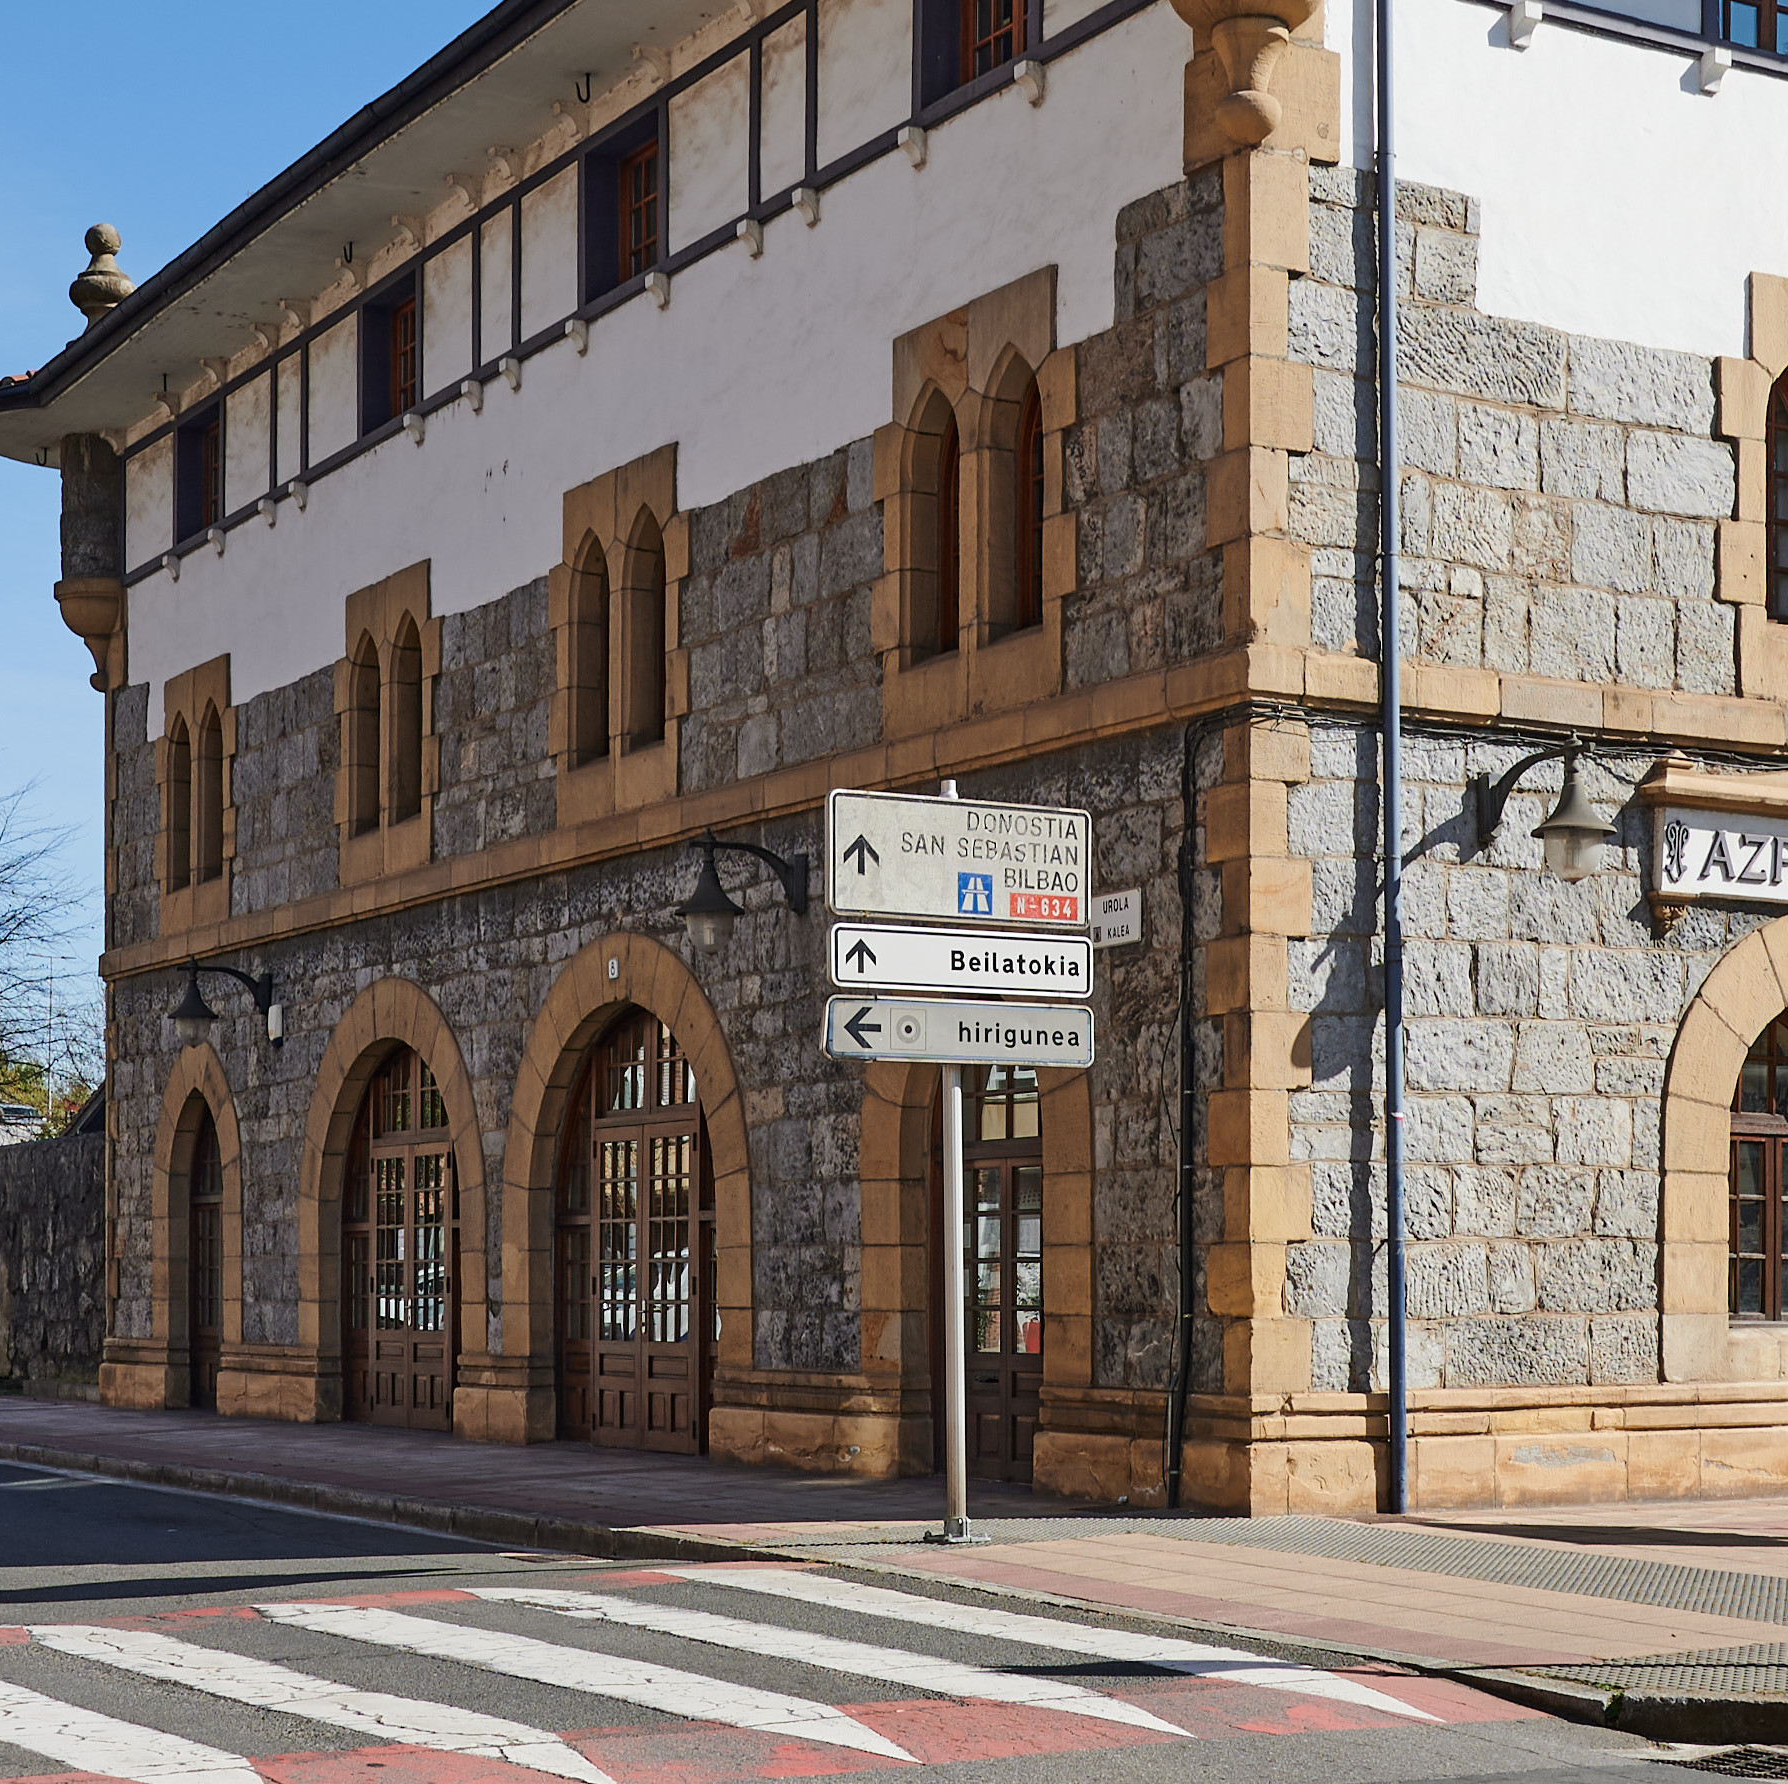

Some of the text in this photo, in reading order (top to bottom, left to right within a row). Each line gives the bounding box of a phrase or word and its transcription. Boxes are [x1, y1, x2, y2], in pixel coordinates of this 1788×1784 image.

[967, 810, 1078, 841] DONOSTIA
[901, 832, 1079, 866] SAN SEBASTIAN
[1004, 867, 1079, 893] BILBAO
[1016, 895, 1073, 918] N-634
[1102, 896, 1130, 915] UROLA
[1107, 924, 1130, 940] KALEA
[950, 949, 1081, 978] Beilatokia
[958, 1020, 1081, 1049] hirigunea
